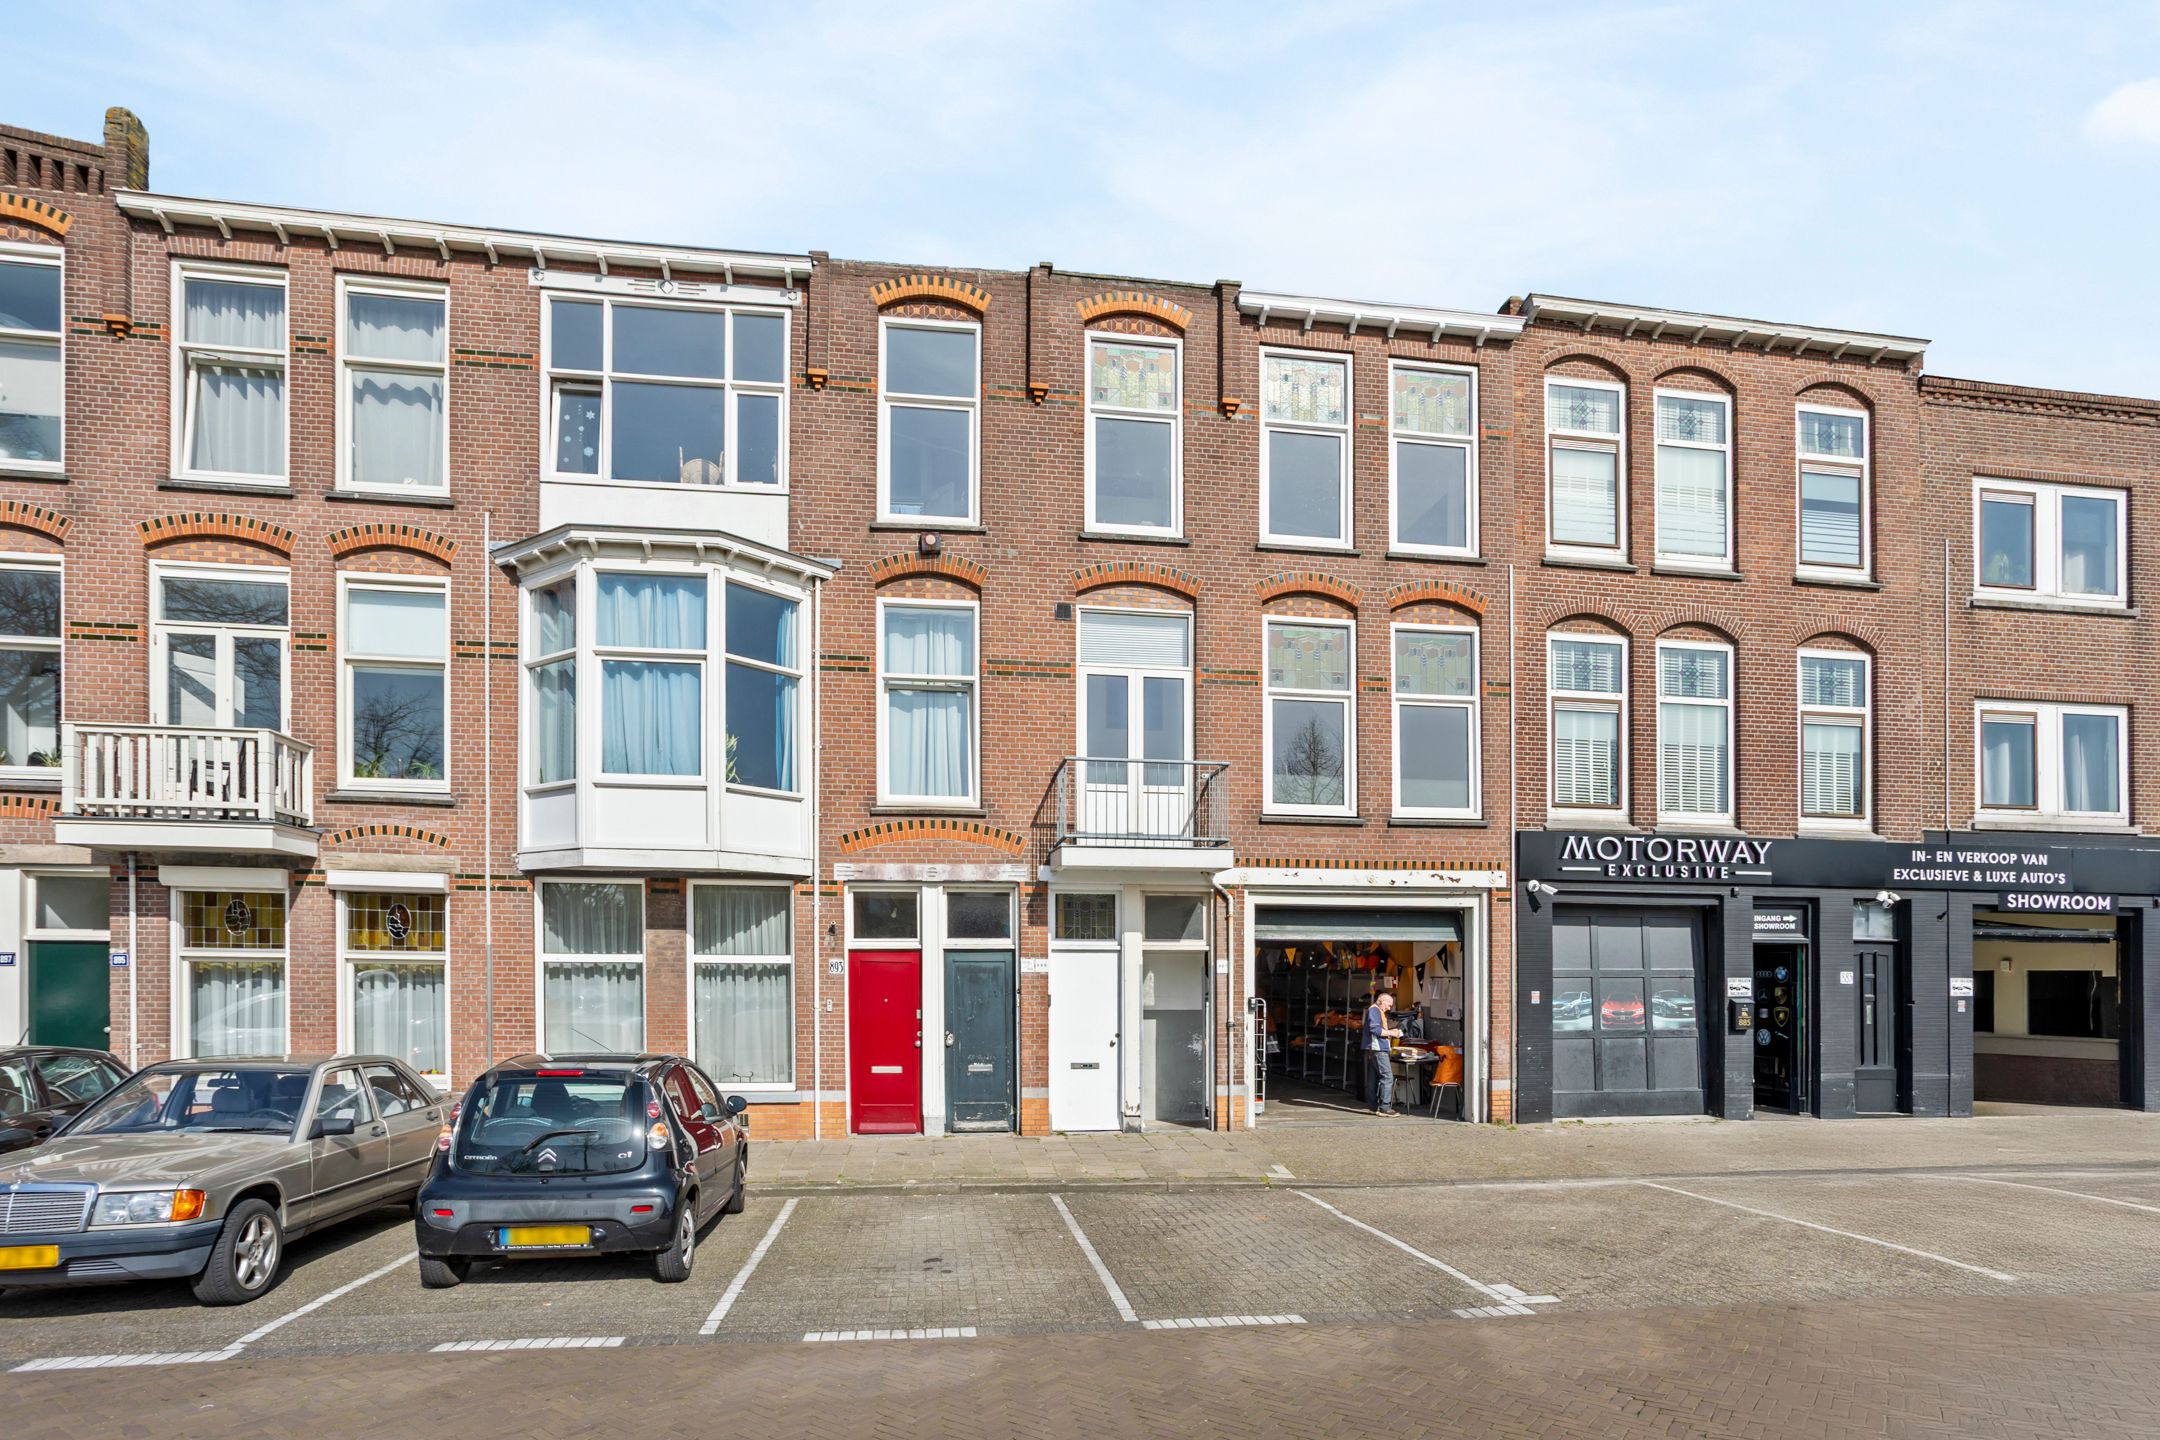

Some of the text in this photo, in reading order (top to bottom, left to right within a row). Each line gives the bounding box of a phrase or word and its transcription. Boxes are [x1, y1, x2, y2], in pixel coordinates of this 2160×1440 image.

[1561, 835, 1773, 864] MOTORWAY
[1912, 850, 2048, 866] IN- EN VERKOOP VAN
[1608, 864, 1729, 879] EXCLUSIVE
[1893, 868, 2066, 885] EXCLUSIEVE & LUXE AUTO'S
[2007, 893, 2111, 911] SHOWROOM
